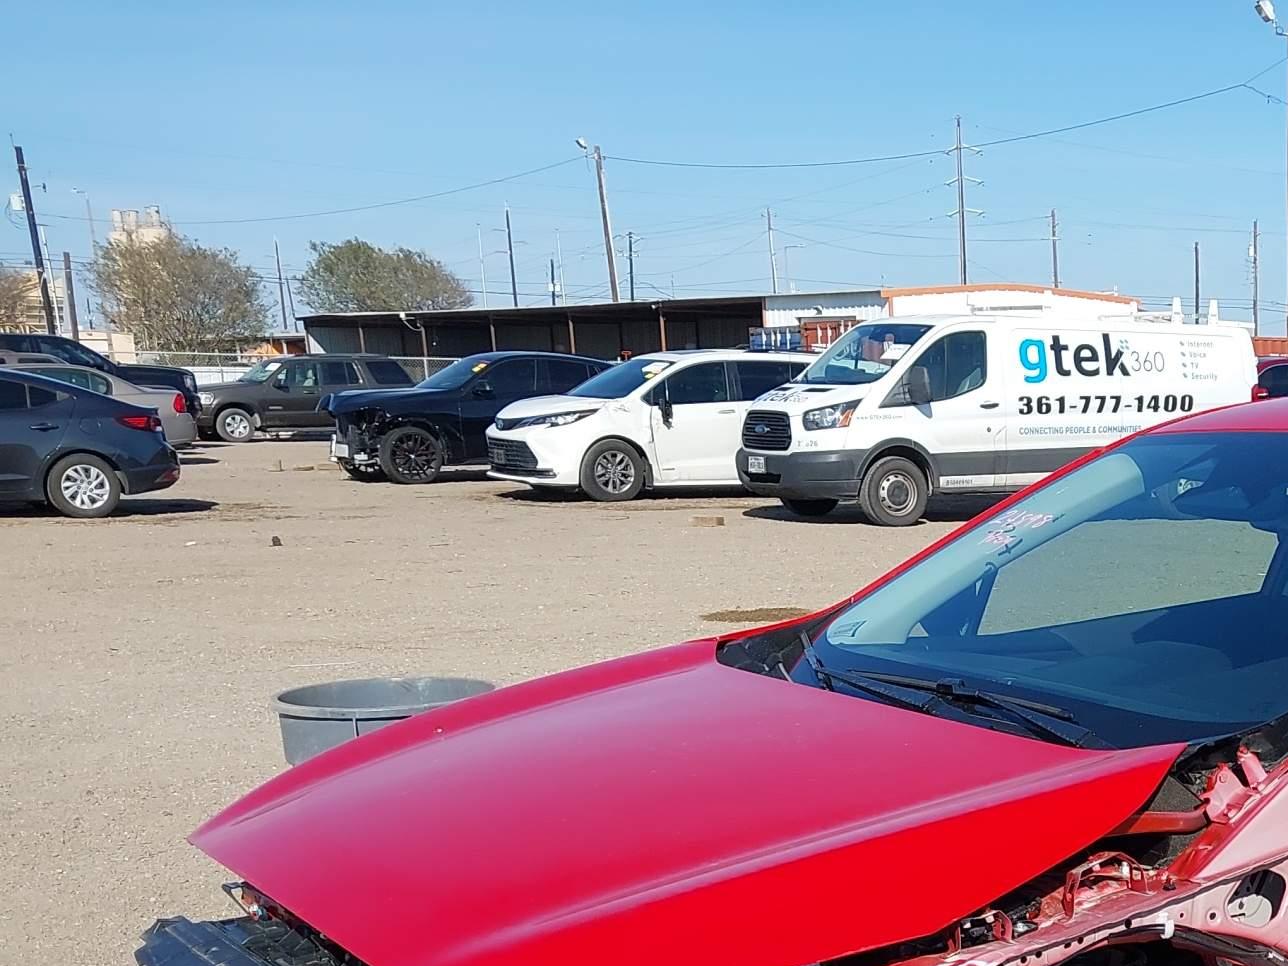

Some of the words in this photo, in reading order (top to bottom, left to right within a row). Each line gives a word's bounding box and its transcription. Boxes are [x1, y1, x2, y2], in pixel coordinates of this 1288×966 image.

[1018, 394, 1194, 415] 361-777-1400
[1019, 427, 1064, 435] CONNECTING
[1065, 426, 1090, 434] PEOPLE
